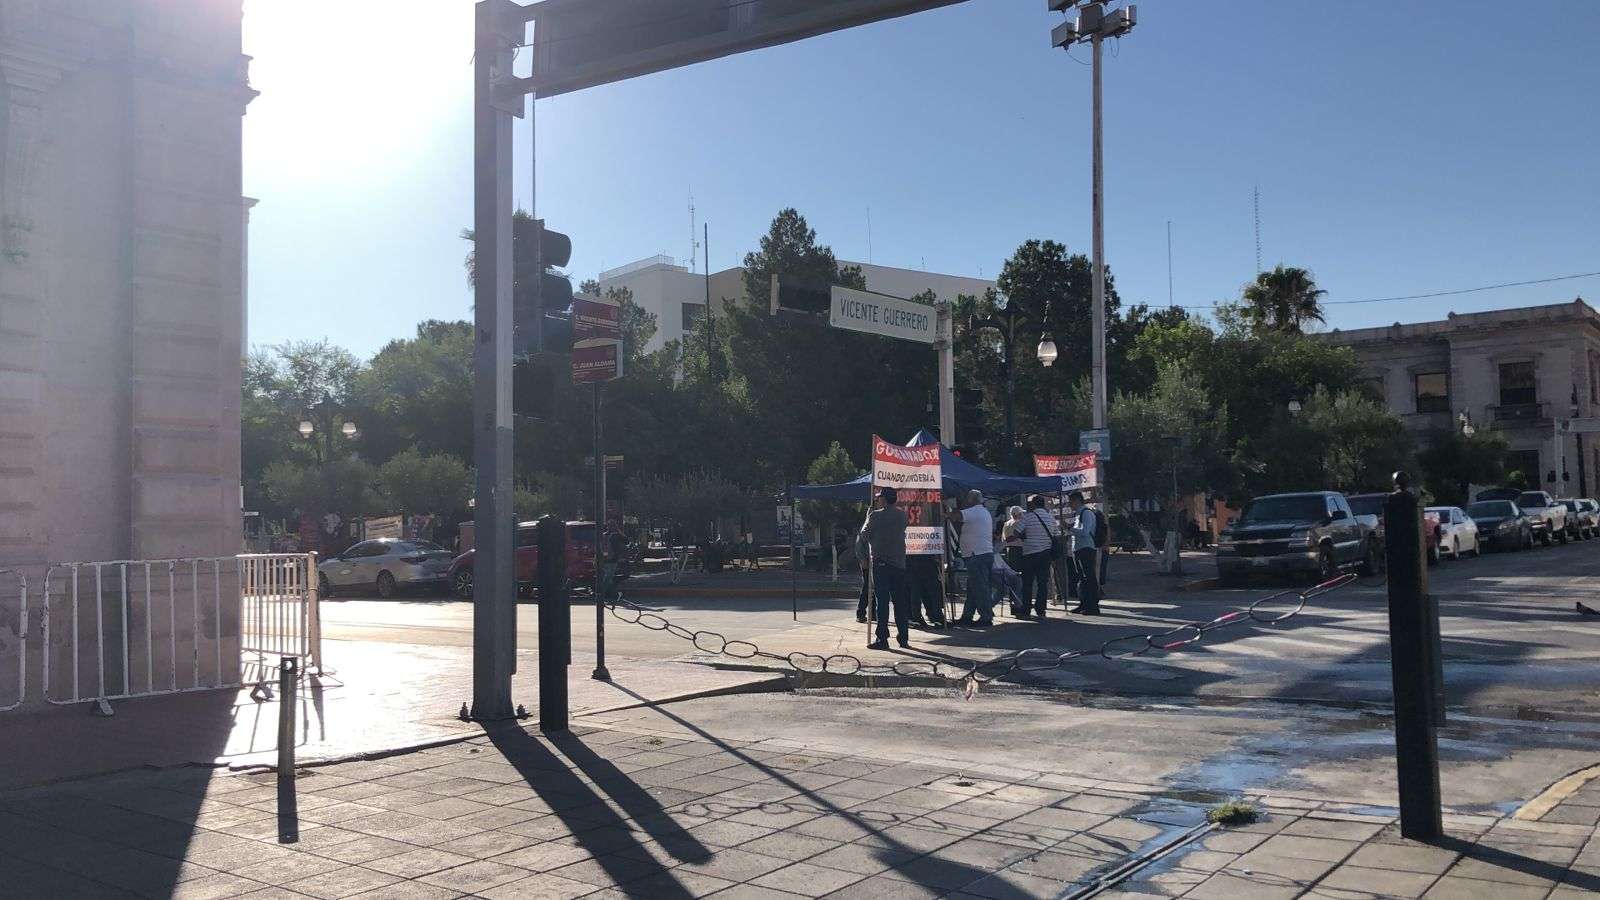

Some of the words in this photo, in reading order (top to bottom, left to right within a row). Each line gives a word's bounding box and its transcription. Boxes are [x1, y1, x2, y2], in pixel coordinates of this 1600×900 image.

[840, 297, 879, 323] VICENTE
[883, 307, 928, 331] GUERRERO
[594, 359, 616, 368] ALDAMA
[877, 470, 905, 483] CUANDO
[927, 491, 941, 503] DE
